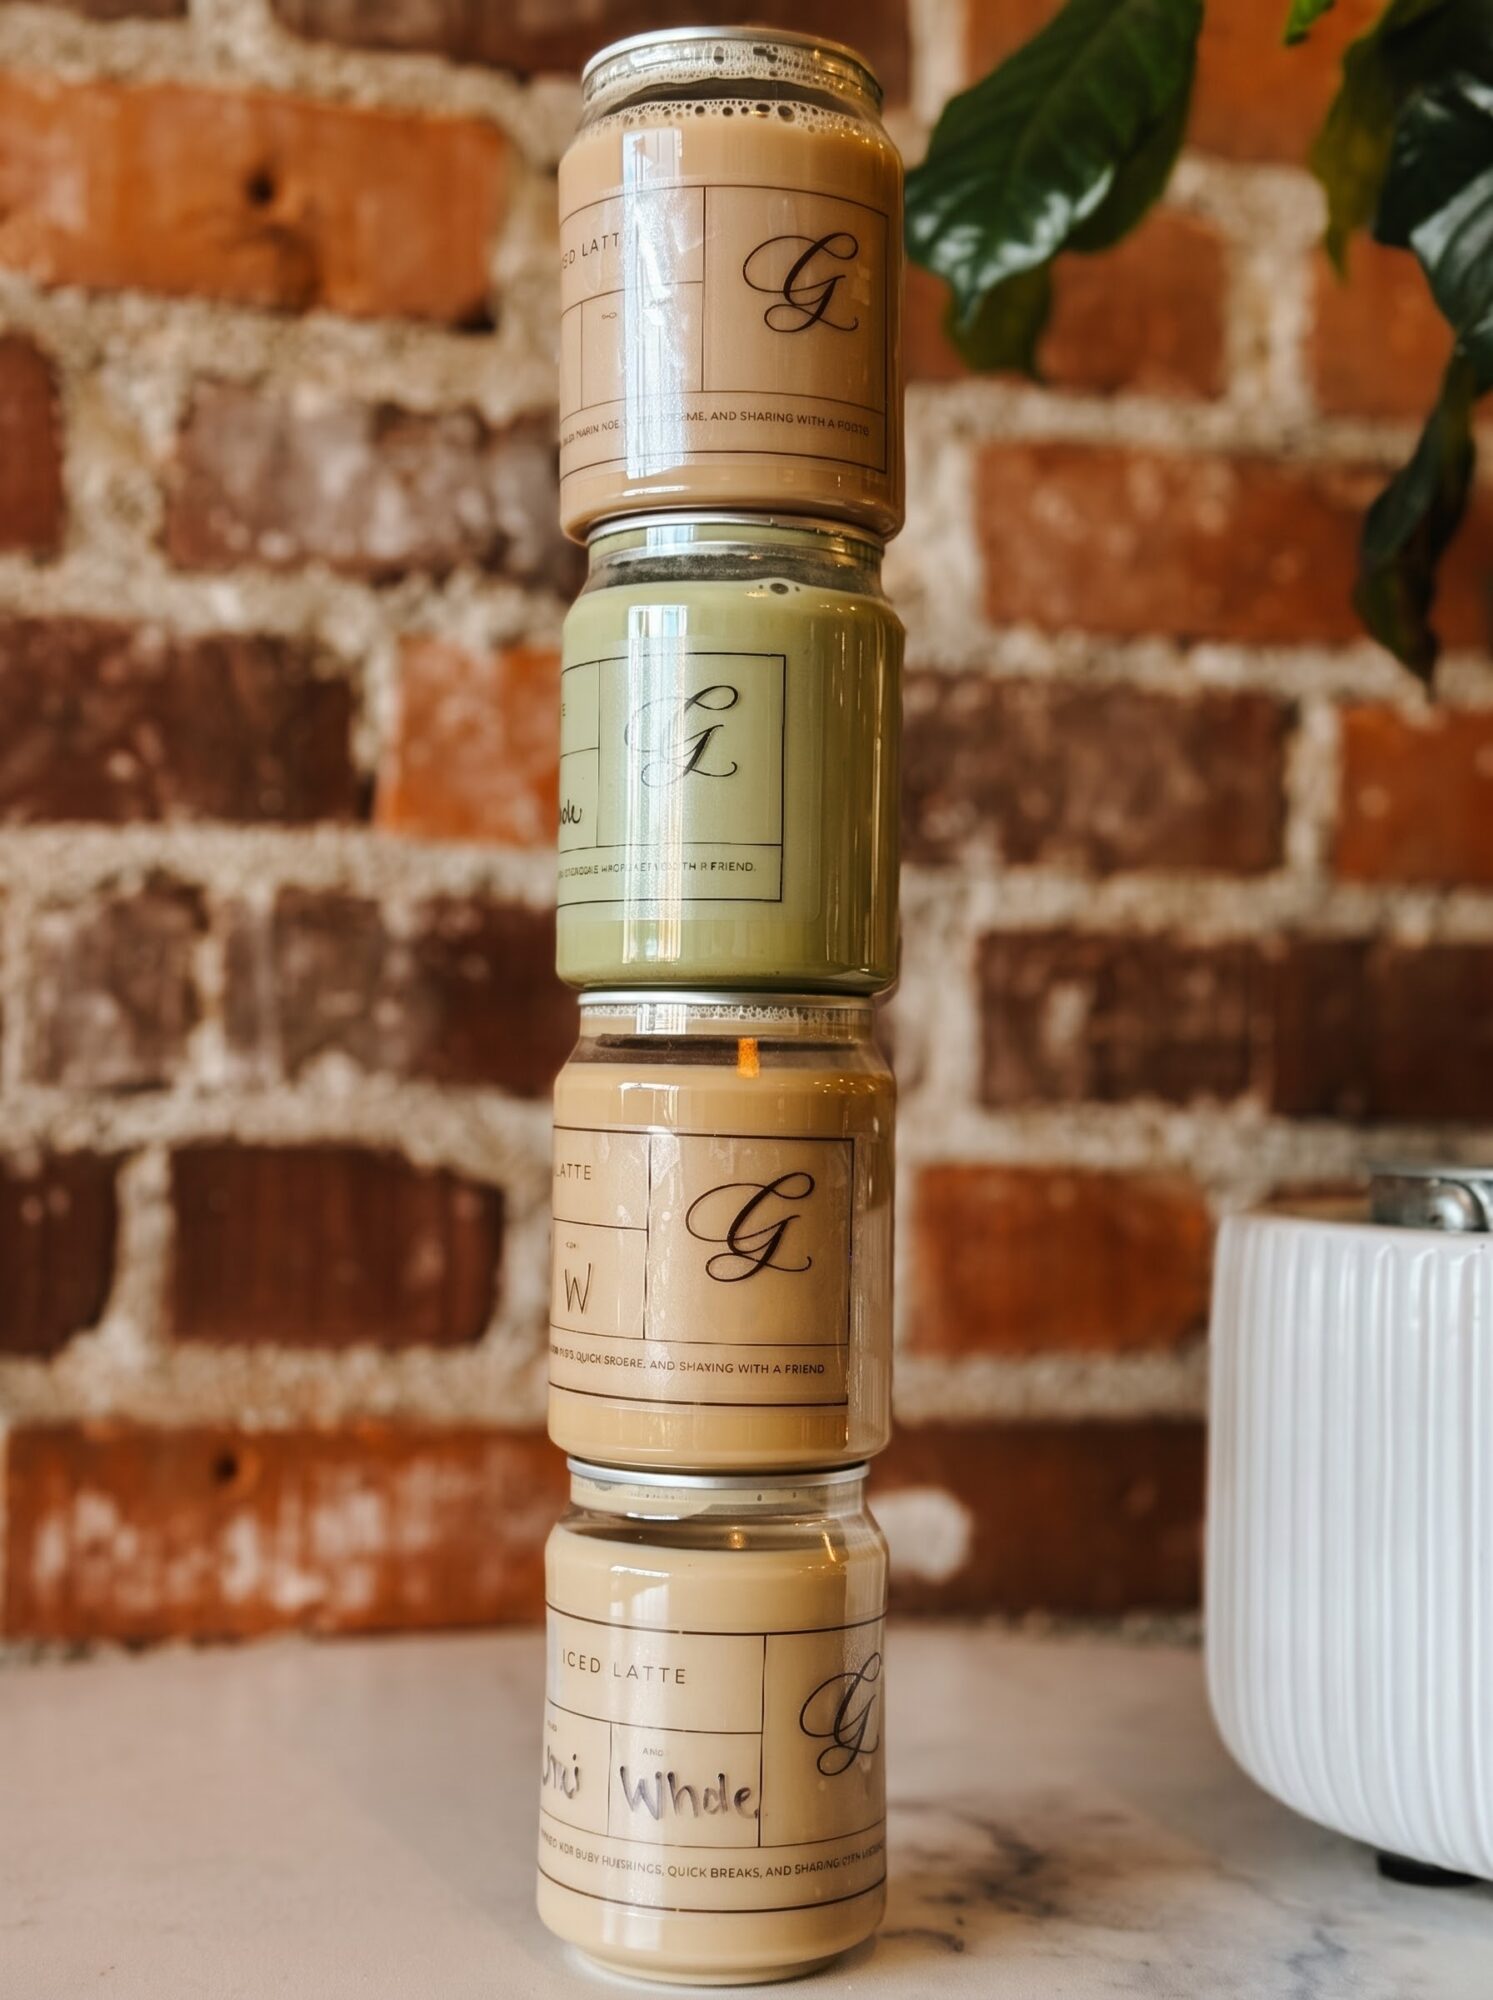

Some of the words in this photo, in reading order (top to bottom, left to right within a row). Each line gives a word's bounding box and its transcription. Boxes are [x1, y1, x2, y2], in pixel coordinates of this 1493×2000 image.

[581, 231, 620, 257] LATT
[710, 411, 737, 421] AND
[740, 411, 794, 424] SHARING
[796, 415, 826, 428] WITH
[827, 419, 836, 429] A
[564, 1262, 592, 1314] W
[649, 1360, 676, 1371] AND
[738, 1363, 769, 1374] WITH
[773, 1364, 782, 1374] A
[785, 1364, 826, 1374] FRIEND
[562, 1647, 601, 1674] ICED
[612, 1661, 687, 1685] LATTE
[667, 1865, 708, 1879] QUICK
[710, 1867, 763, 1879] BREAKS,
[765, 1865, 792, 1877] AND
